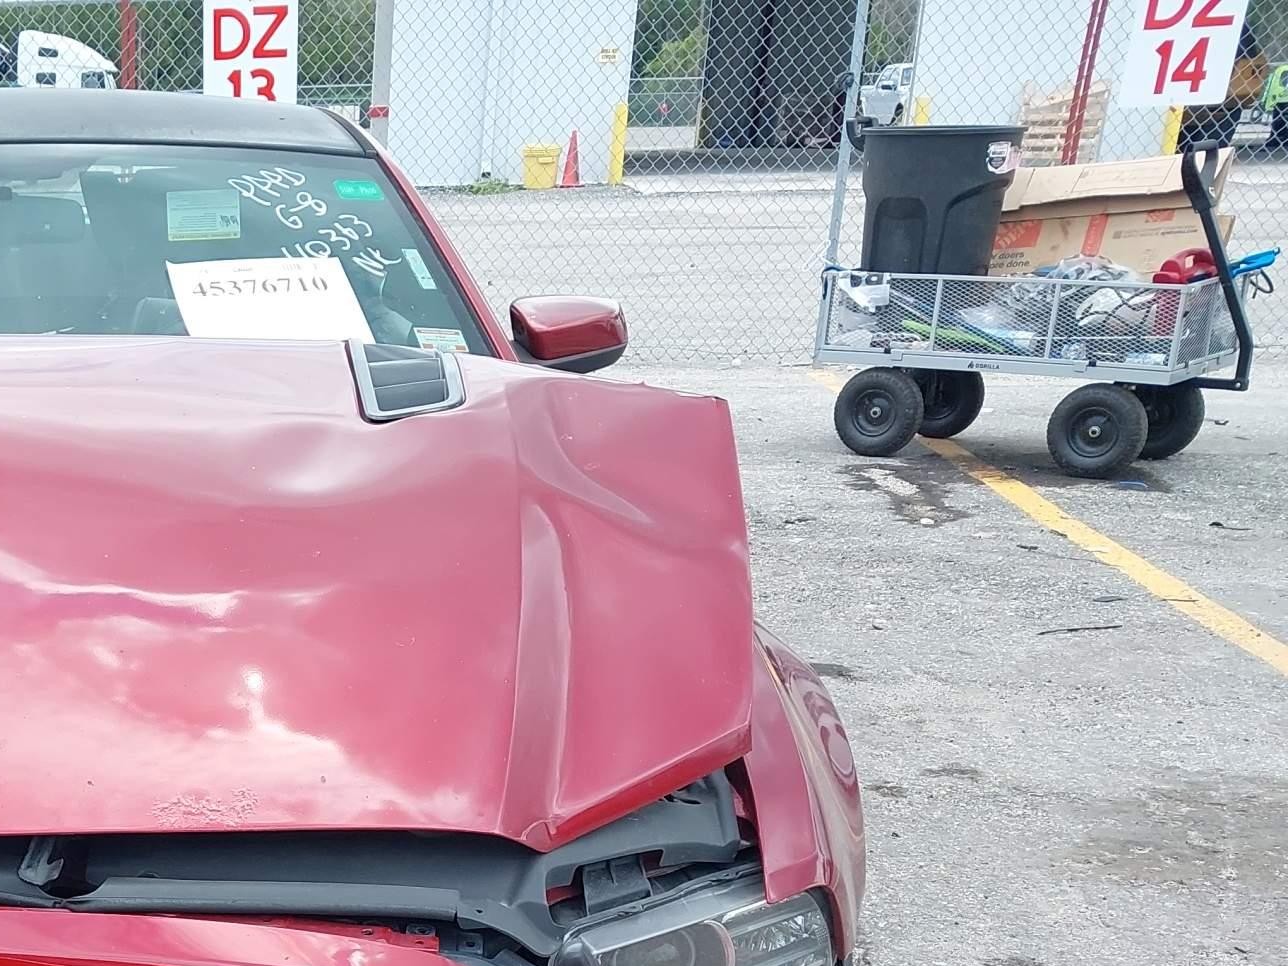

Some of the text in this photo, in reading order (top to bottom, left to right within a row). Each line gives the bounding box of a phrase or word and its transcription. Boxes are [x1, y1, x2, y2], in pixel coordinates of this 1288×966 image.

[213, 5, 288, 60] DZ
[227, 68, 277, 101] 13
[1154, 36, 1211, 95] 14
[192, 276, 328, 297] 45376710
